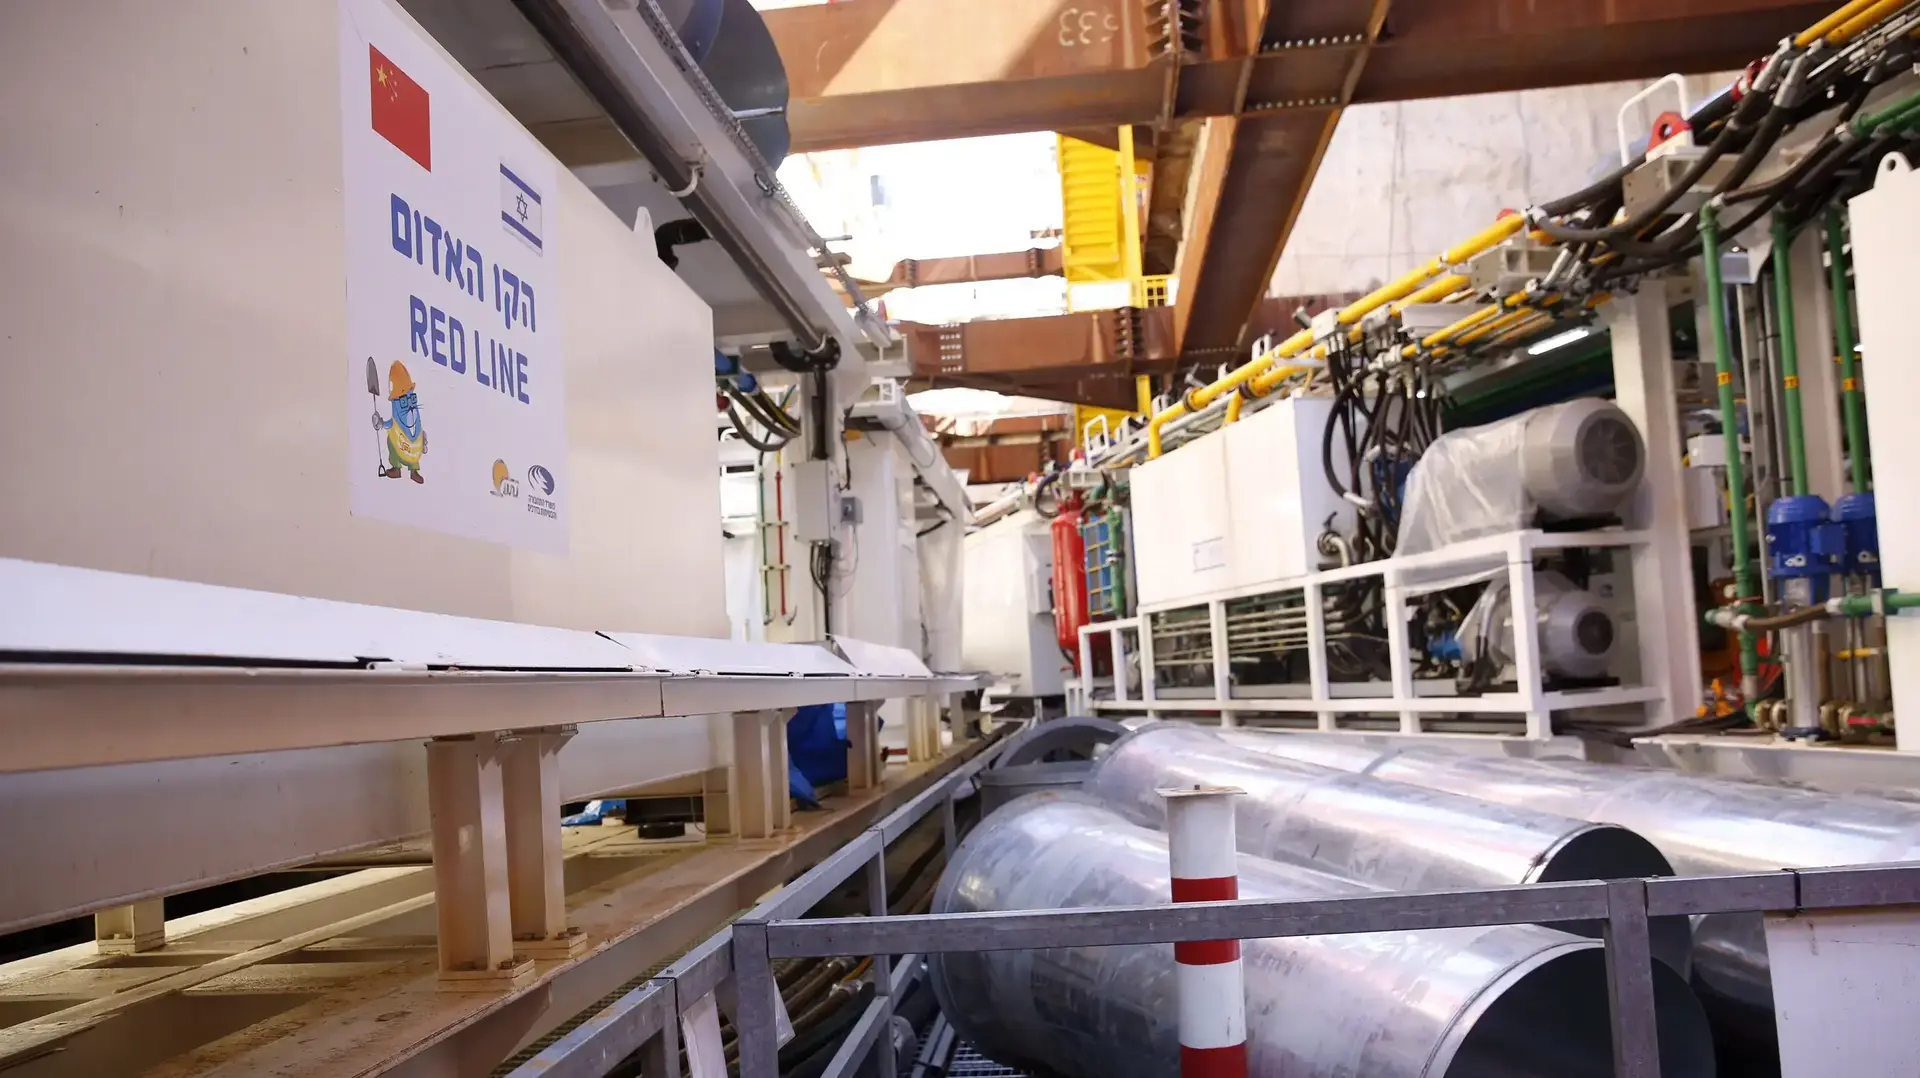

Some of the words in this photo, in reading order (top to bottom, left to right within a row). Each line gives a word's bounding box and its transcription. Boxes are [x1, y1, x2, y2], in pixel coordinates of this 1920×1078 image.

[390, 192, 485, 302] האדום
[493, 263, 536, 333] הקו
[409, 294, 467, 375] RED
[474, 330, 530, 405] LINE
